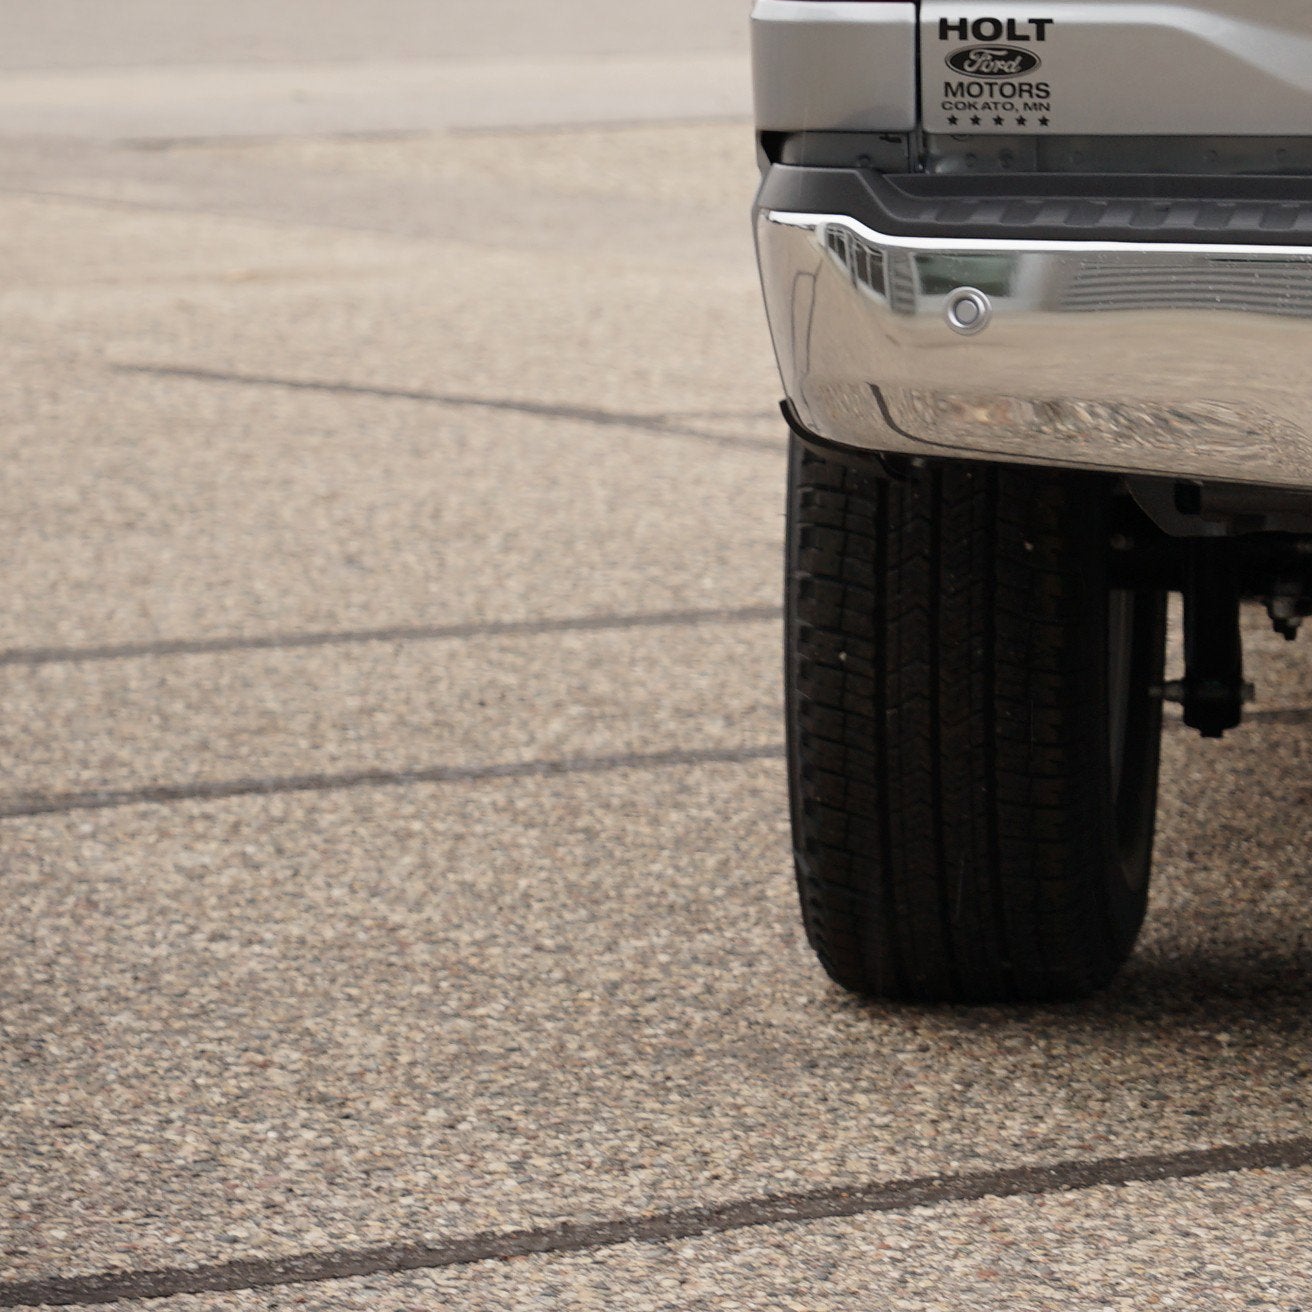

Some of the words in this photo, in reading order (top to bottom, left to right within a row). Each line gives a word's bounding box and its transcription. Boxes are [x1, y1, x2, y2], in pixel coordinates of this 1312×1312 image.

[938, 17, 1053, 41] HOLT
[962, 48, 1023, 74] Ford
[943, 81, 1051, 99] MOTORS
[941, 100, 1019, 113] COKATO,
[1023, 101, 1050, 111] MN
